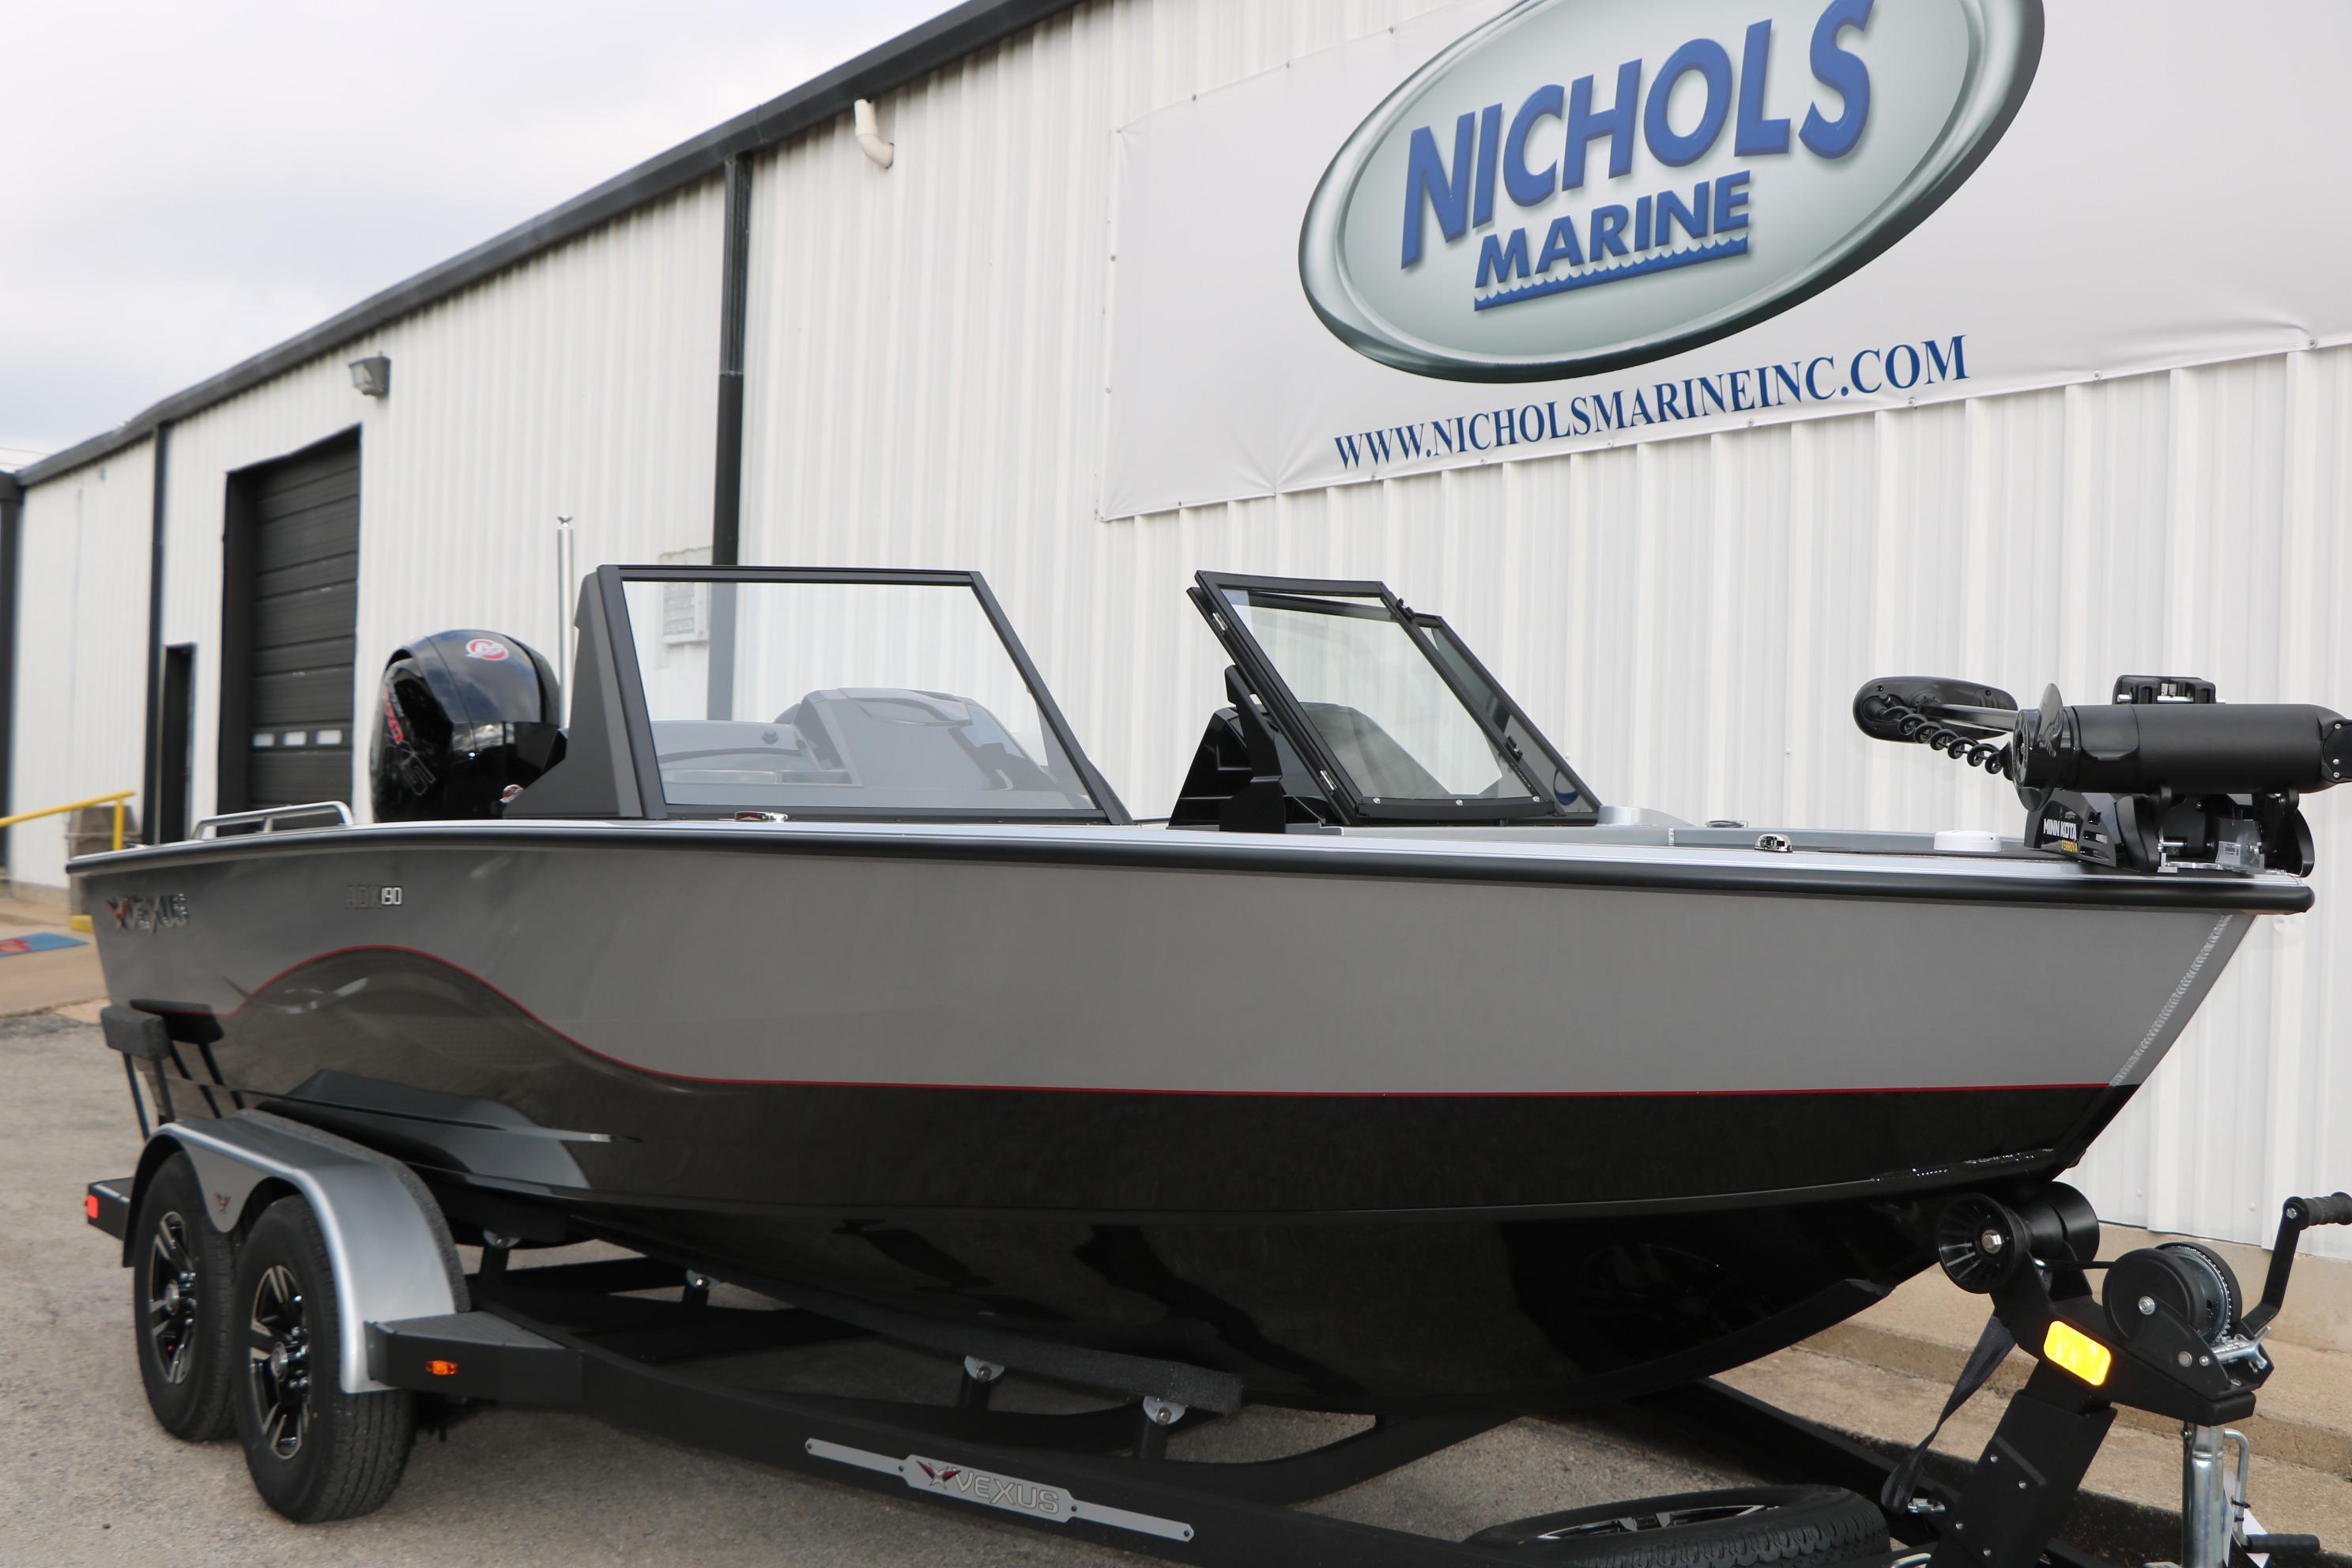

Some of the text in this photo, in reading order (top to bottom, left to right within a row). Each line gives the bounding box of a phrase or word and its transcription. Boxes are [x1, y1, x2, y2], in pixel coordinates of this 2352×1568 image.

[1400, 0, 1875, 270] NICHOLS
[1475, 171, 1751, 288] MARINE
[1333, 334, 1970, 469] WWW.NICHOLSMARINEINC.COM
[2043, 818, 2077, 841] MINN KOTA
[951, 1466, 1060, 1515] VEXUS
